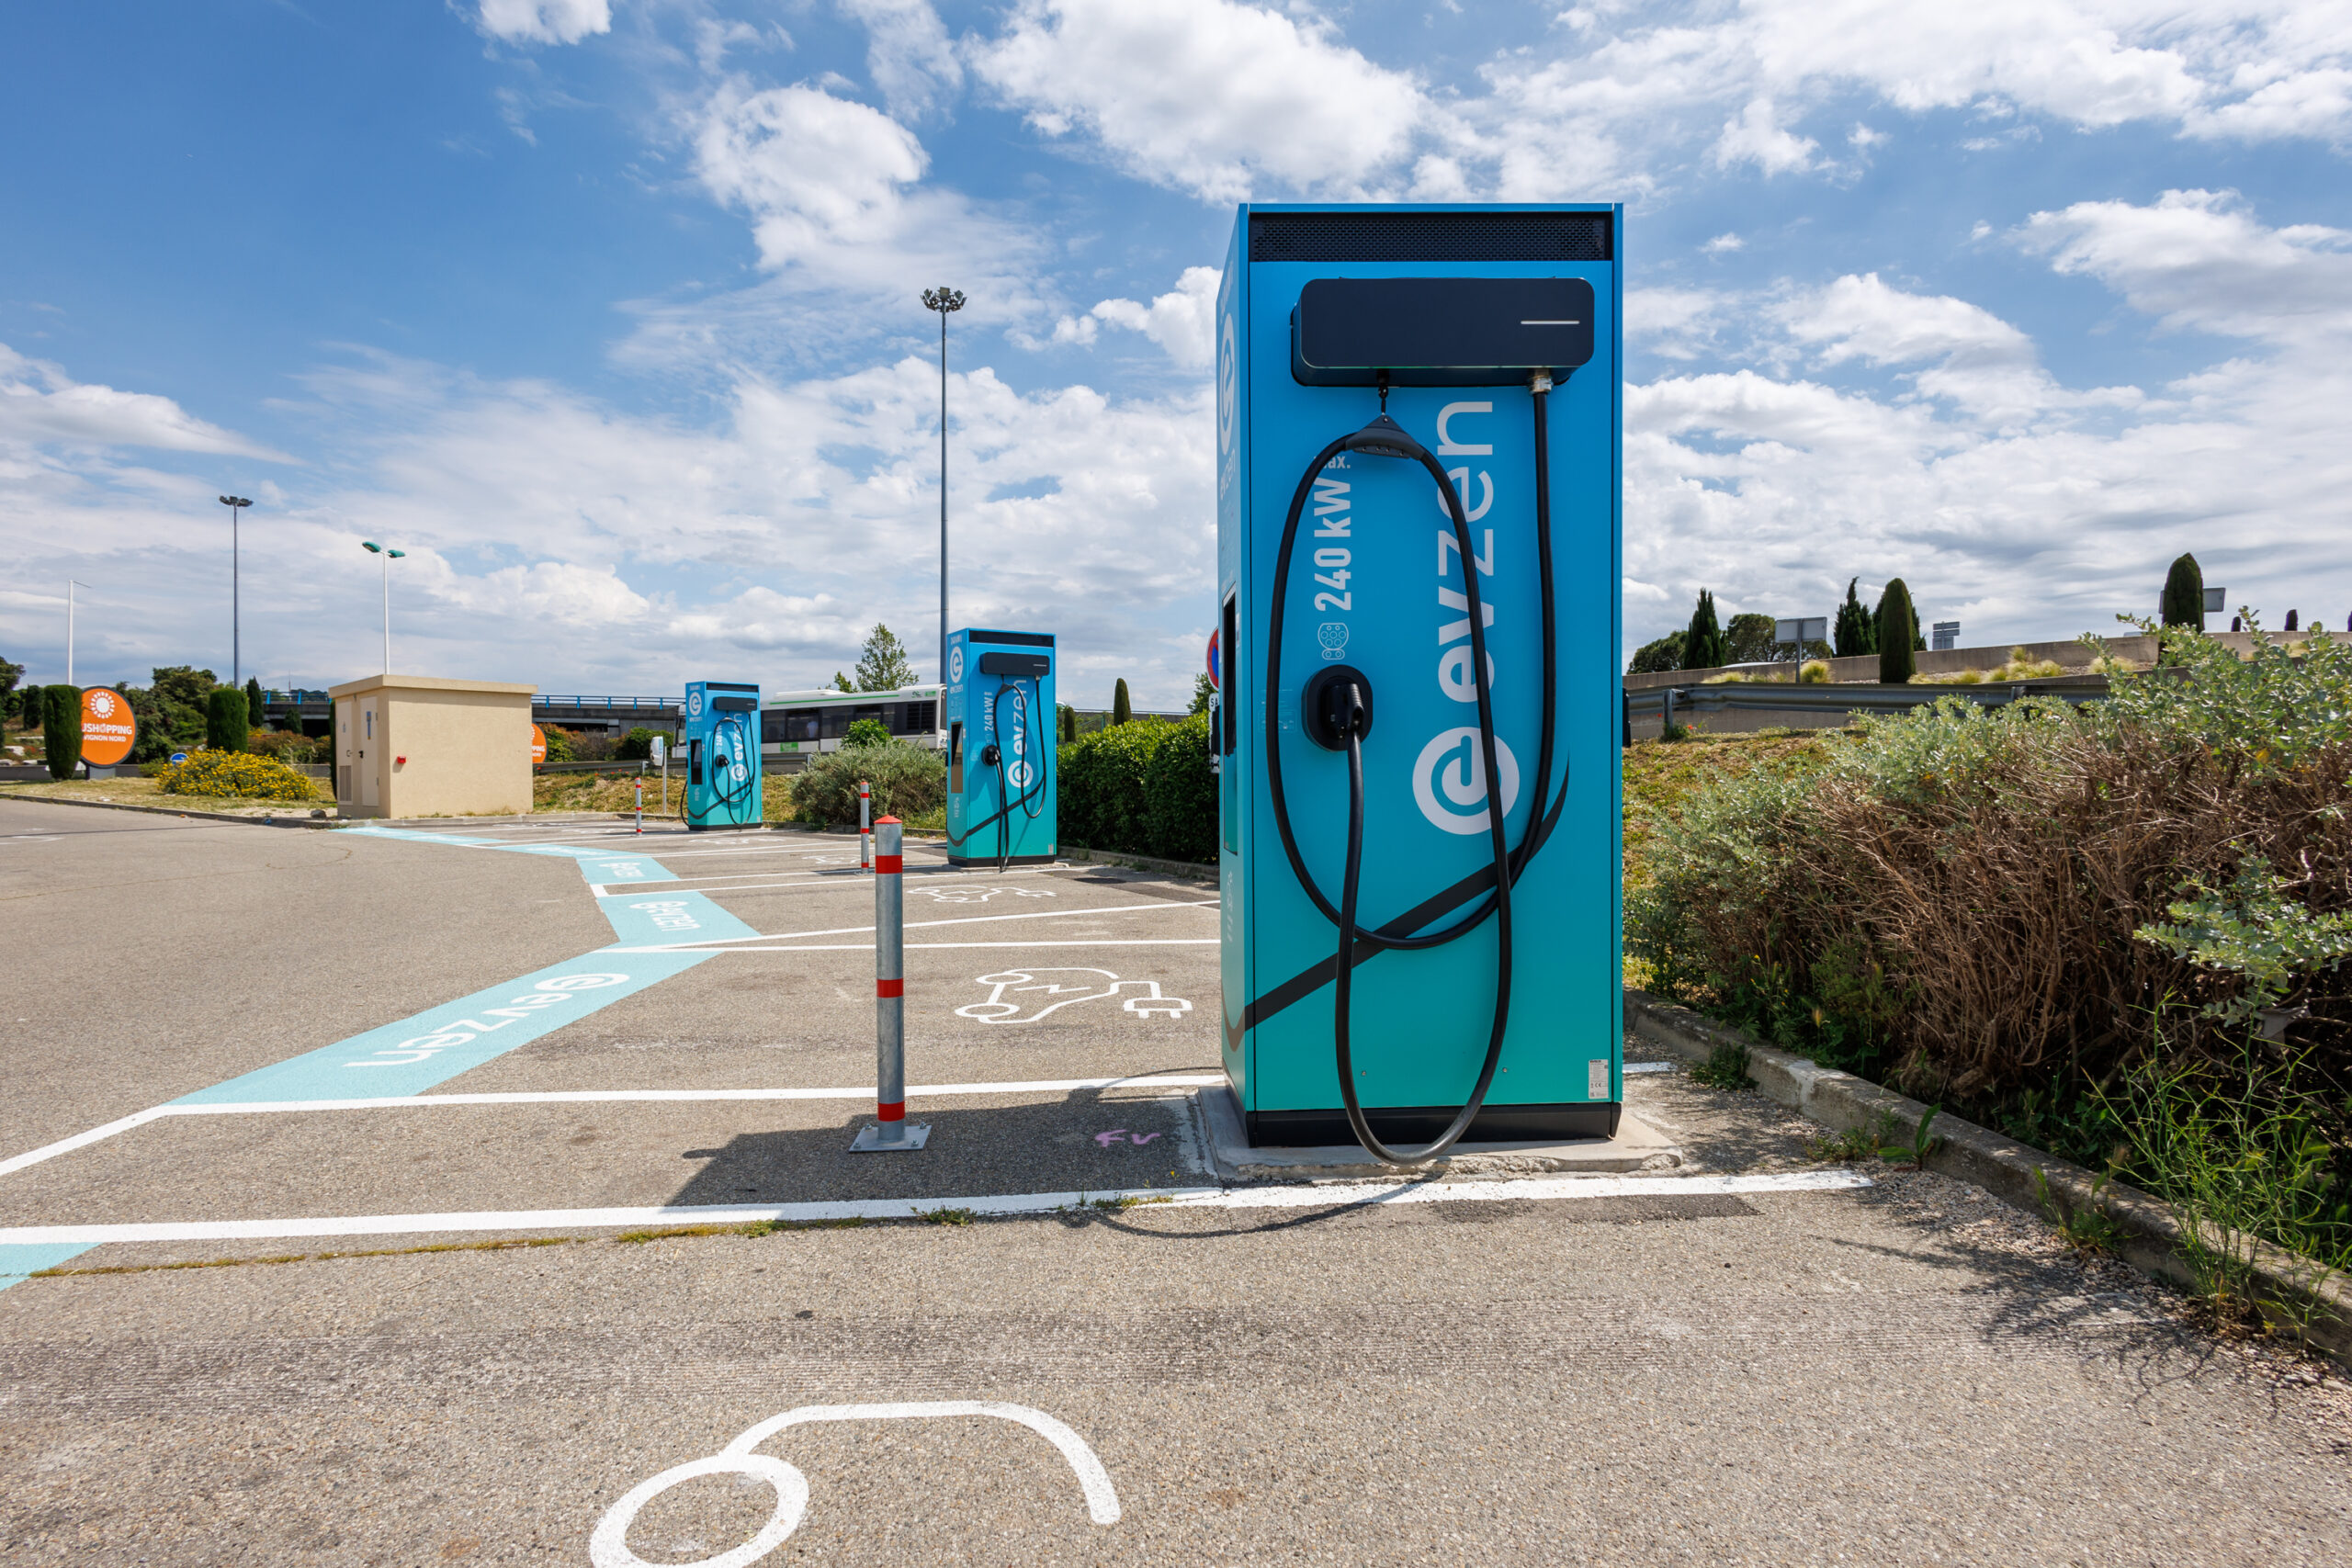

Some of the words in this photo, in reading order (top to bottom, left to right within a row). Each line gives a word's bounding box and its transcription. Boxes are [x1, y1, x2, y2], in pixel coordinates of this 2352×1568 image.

[1313, 455, 1351, 469] ax.
[1314, 478, 1351, 537] kW
[1314, 547, 1352, 612] 240
[1437, 401, 1495, 703] evzen
[984, 696, 994, 713] kW
[984, 715, 994, 731] 240
[1013, 680, 1028, 756] evzen
[646, 908, 702, 931] evzen
[342, 993, 573, 1067] evzen
